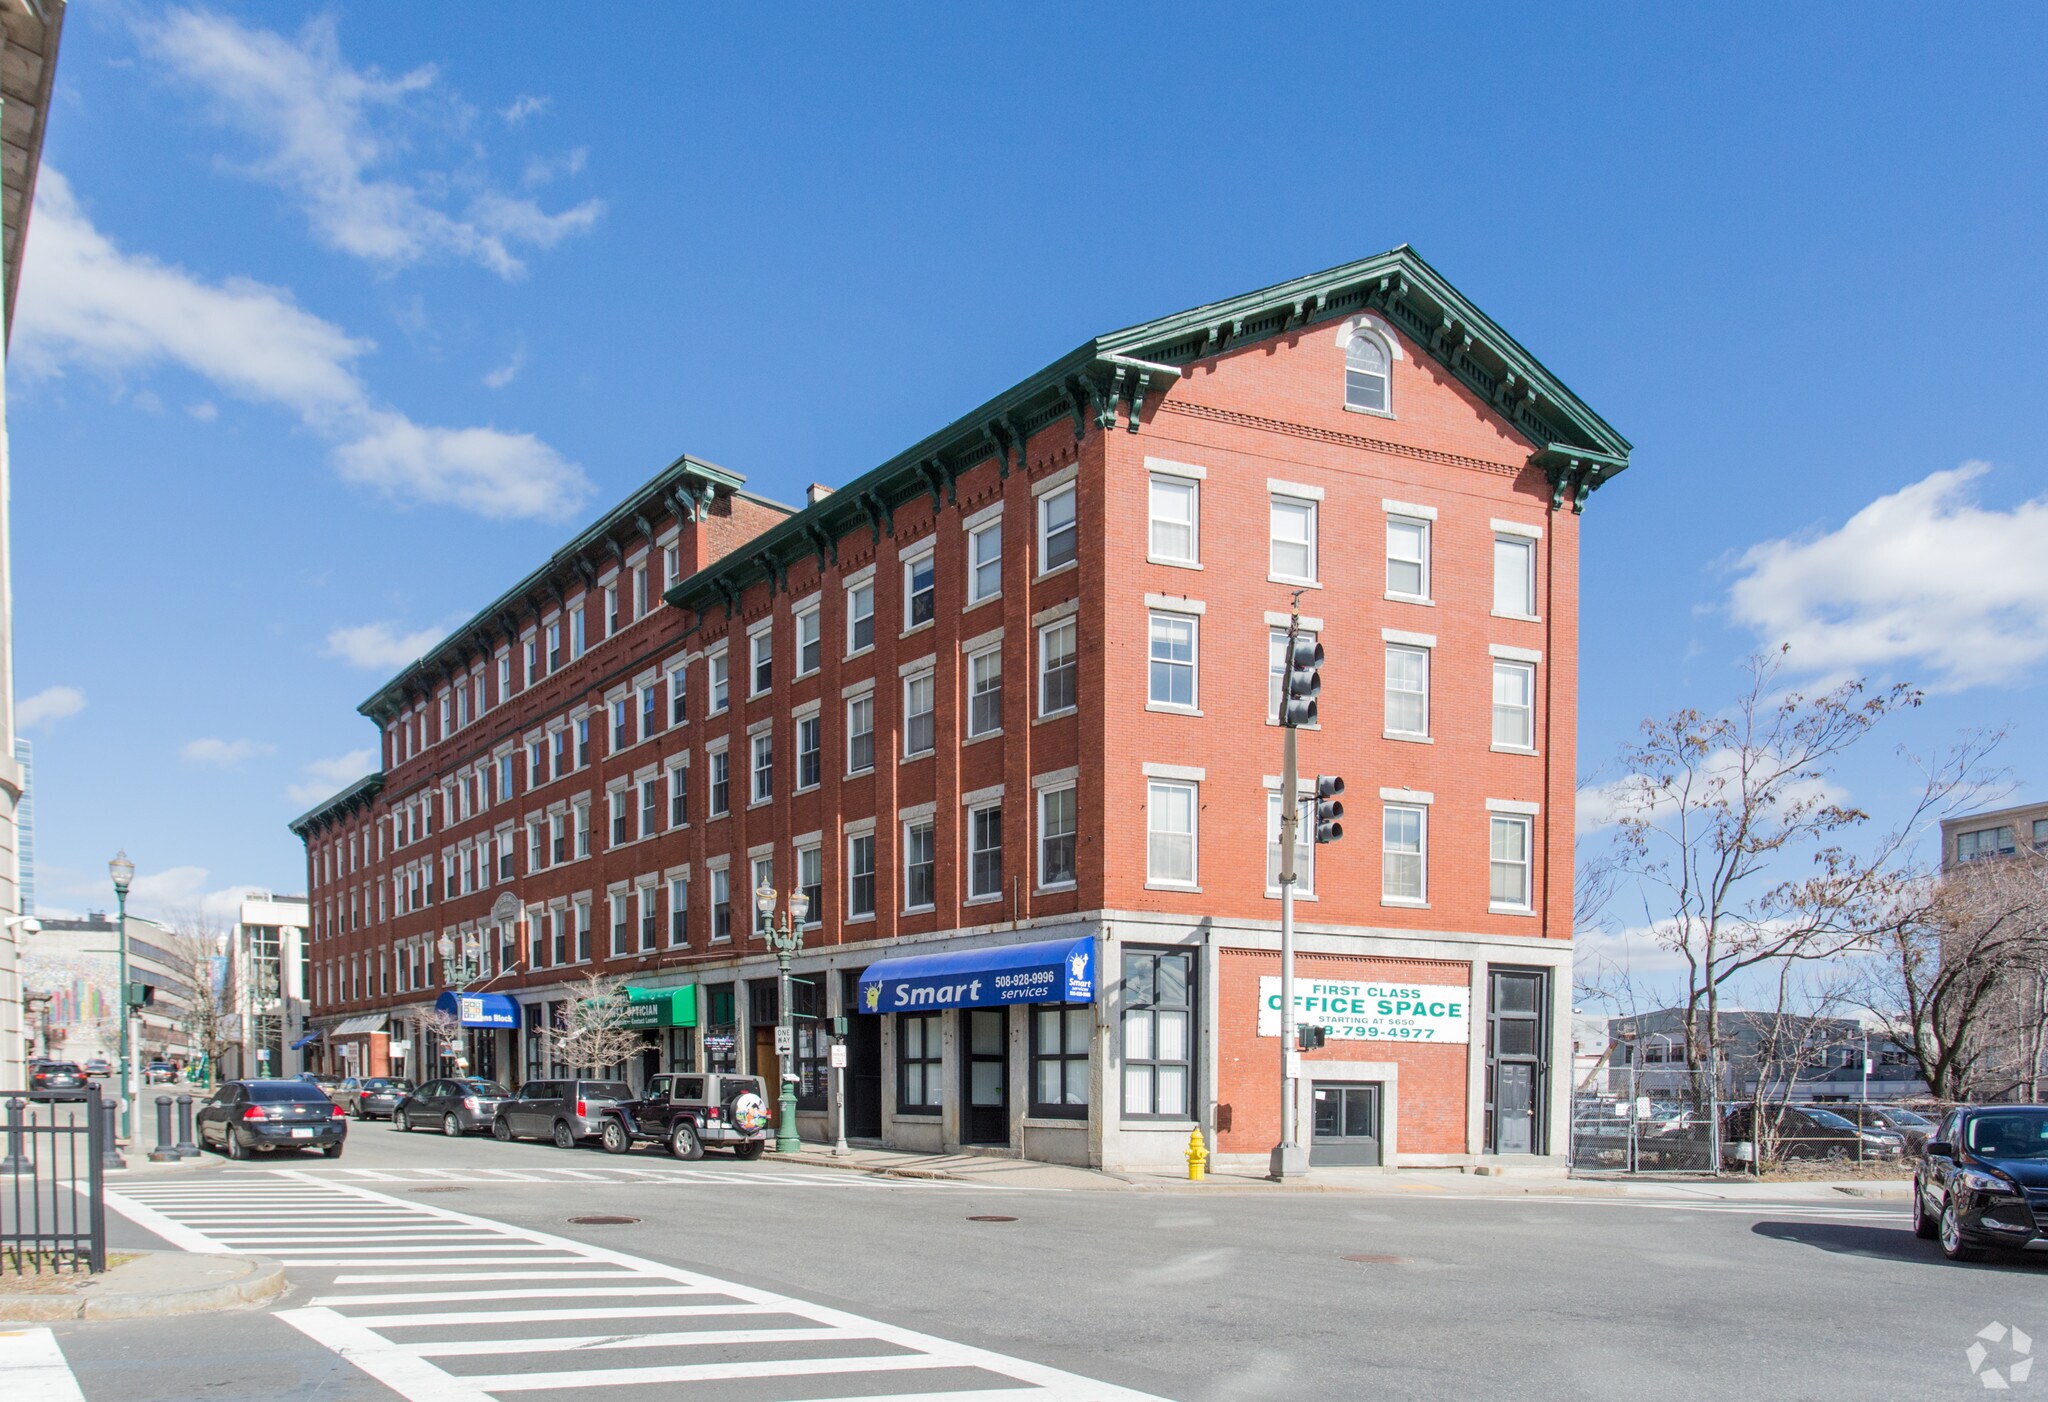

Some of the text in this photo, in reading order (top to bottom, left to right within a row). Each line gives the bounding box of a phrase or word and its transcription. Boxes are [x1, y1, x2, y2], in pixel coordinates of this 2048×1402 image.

[995, 971, 1054, 987] 508-928-9996
[1069, 978, 1091, 988] Smart
[894, 979, 981, 1005] Smart
[1001, 987, 1048, 999] services
[1313, 985, 1421, 999] FIRST CLASS
[627, 1005, 658, 1017] OPTICIAN
[1377, 1000, 1462, 1018] SPACE
[1318, 1015, 1369, 1024] STARTING
[1298, 1022, 1435, 1039] 8-799-4977
[777, 1036, 791, 1044] WAY
